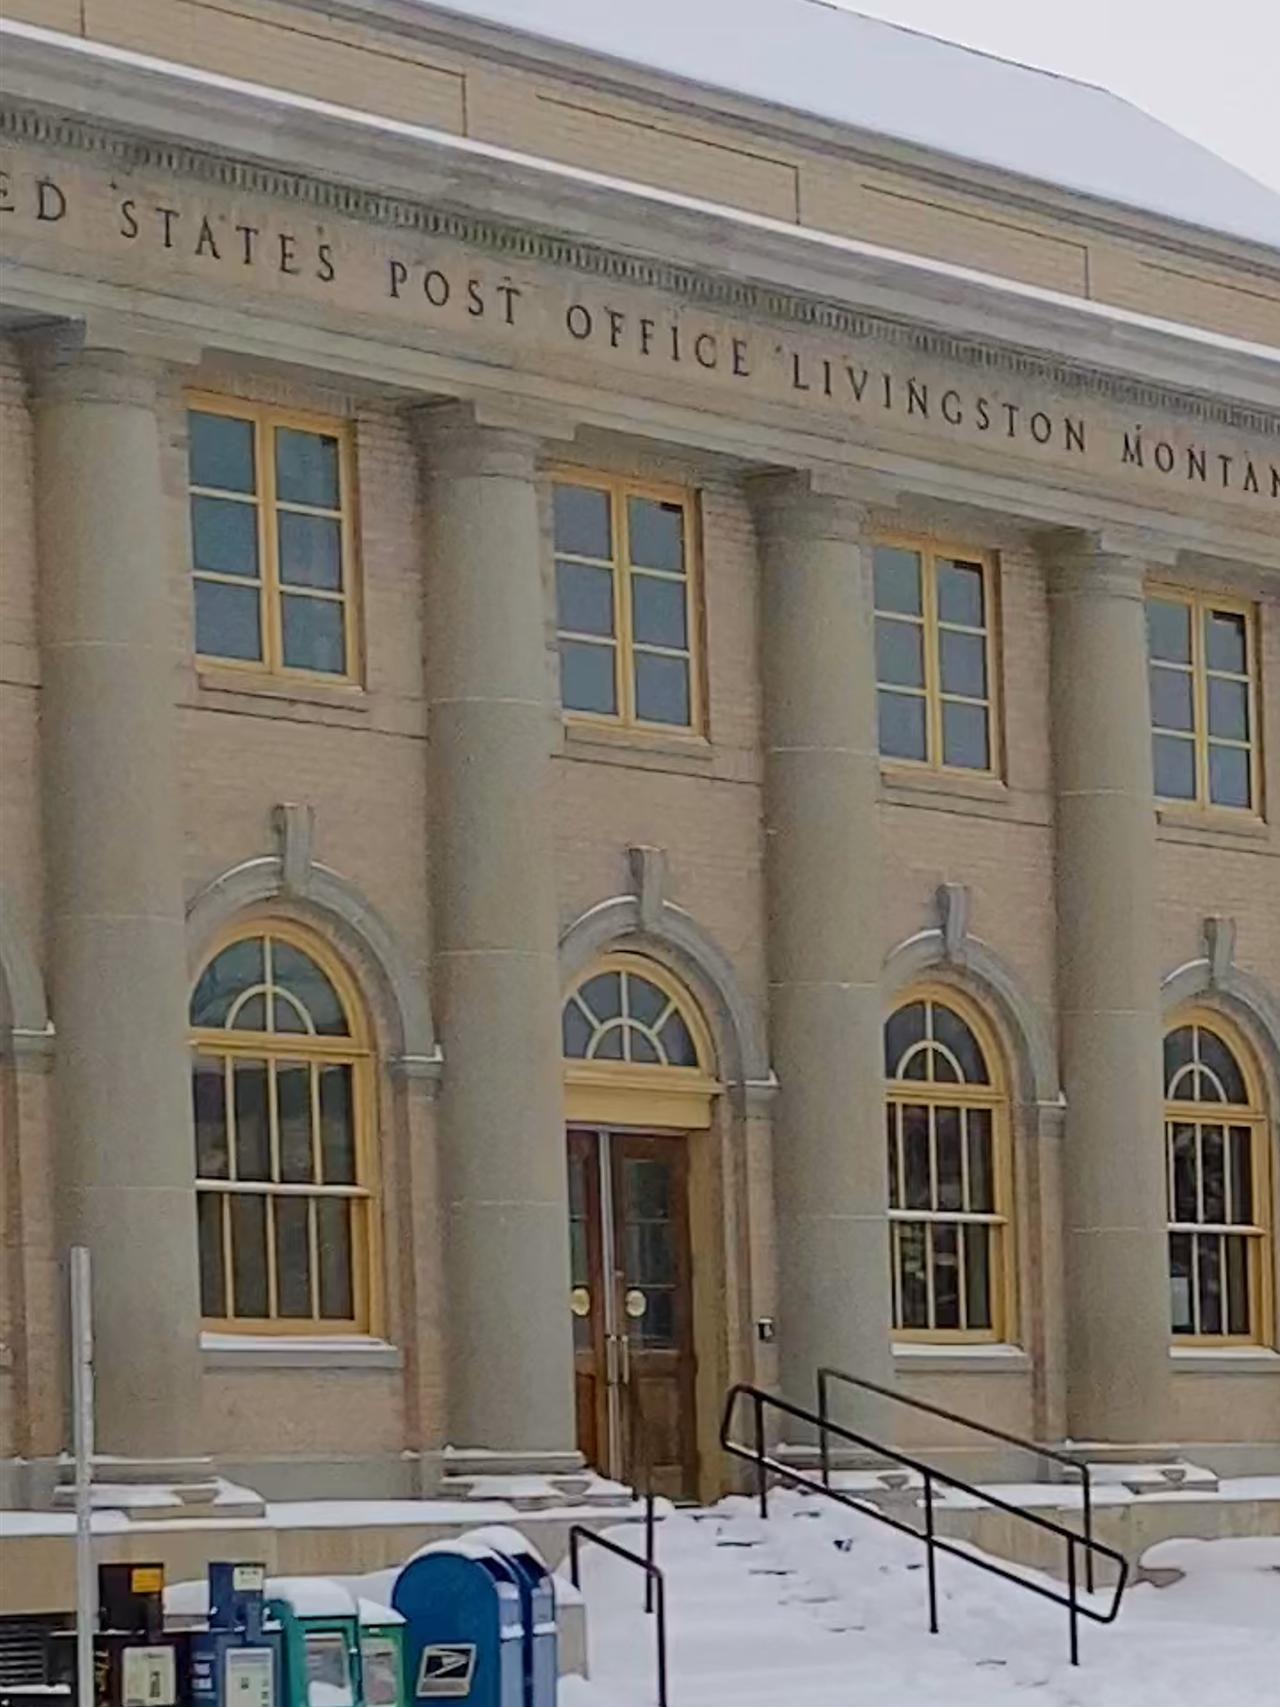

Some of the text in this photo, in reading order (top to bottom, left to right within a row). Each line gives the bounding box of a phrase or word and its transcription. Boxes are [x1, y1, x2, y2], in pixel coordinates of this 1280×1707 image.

[119, 199, 335, 281] STATES
[389, 259, 520, 324] POST
[566, 304, 750, 377] OFFICE
[792, 353, 1087, 454] LIVINGSTON
